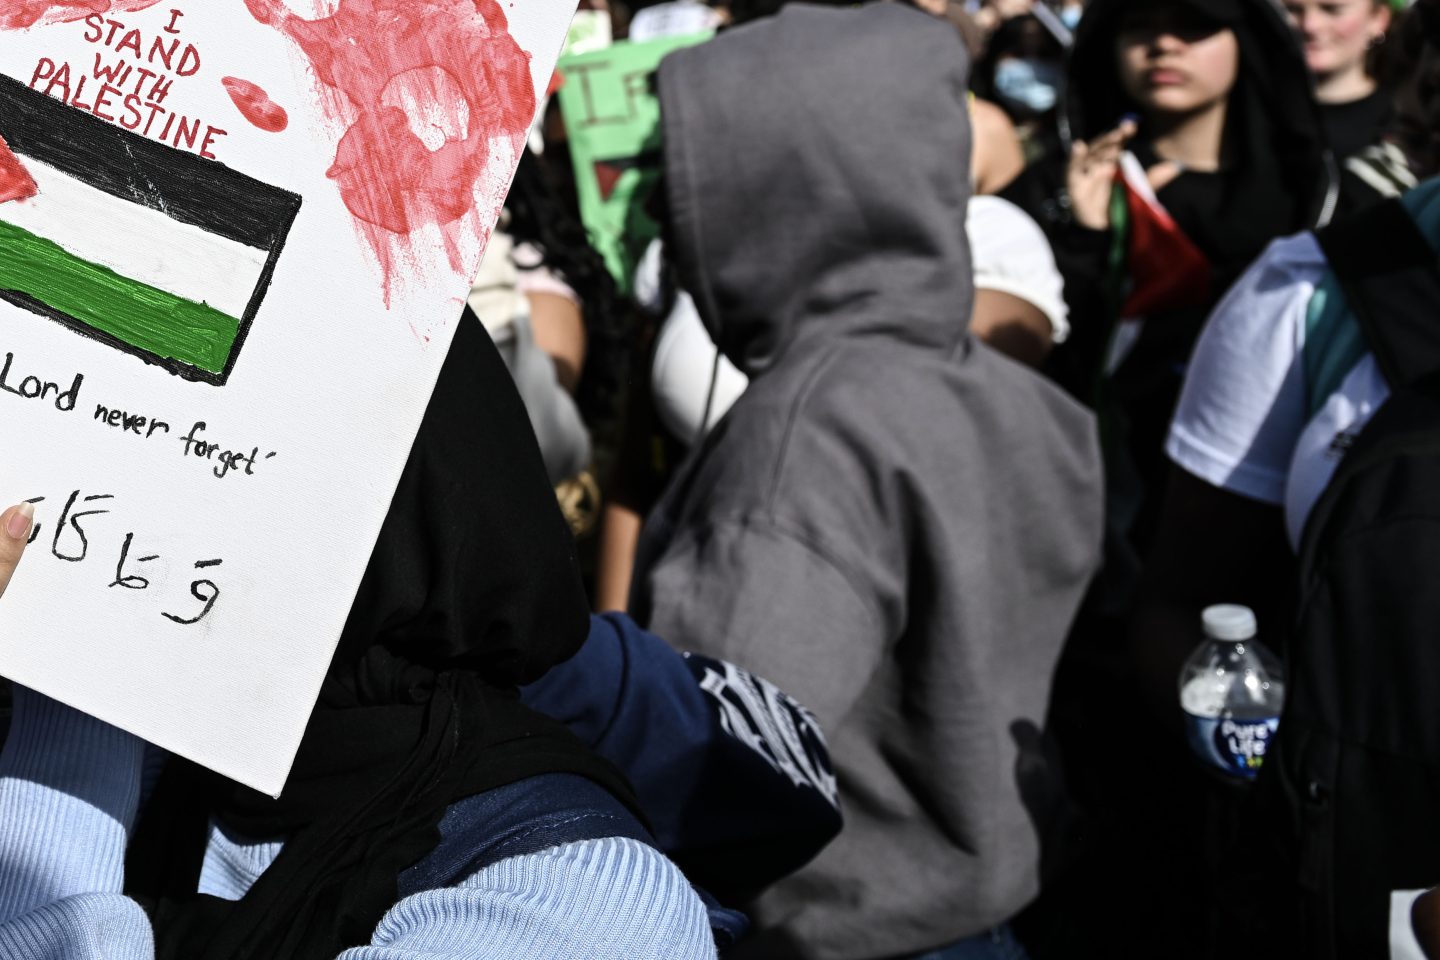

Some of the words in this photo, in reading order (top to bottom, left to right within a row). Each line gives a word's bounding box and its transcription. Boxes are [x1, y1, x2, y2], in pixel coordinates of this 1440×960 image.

[163, 8, 184, 34] I
[83, 12, 201, 77] STAND
[93, 52, 174, 104] WITH
[28, 56, 228, 160] PALESTINE
[93, 403, 170, 439] never
[1221, 720, 1268, 740] Pure
[1228, 736, 1266, 759] Life
